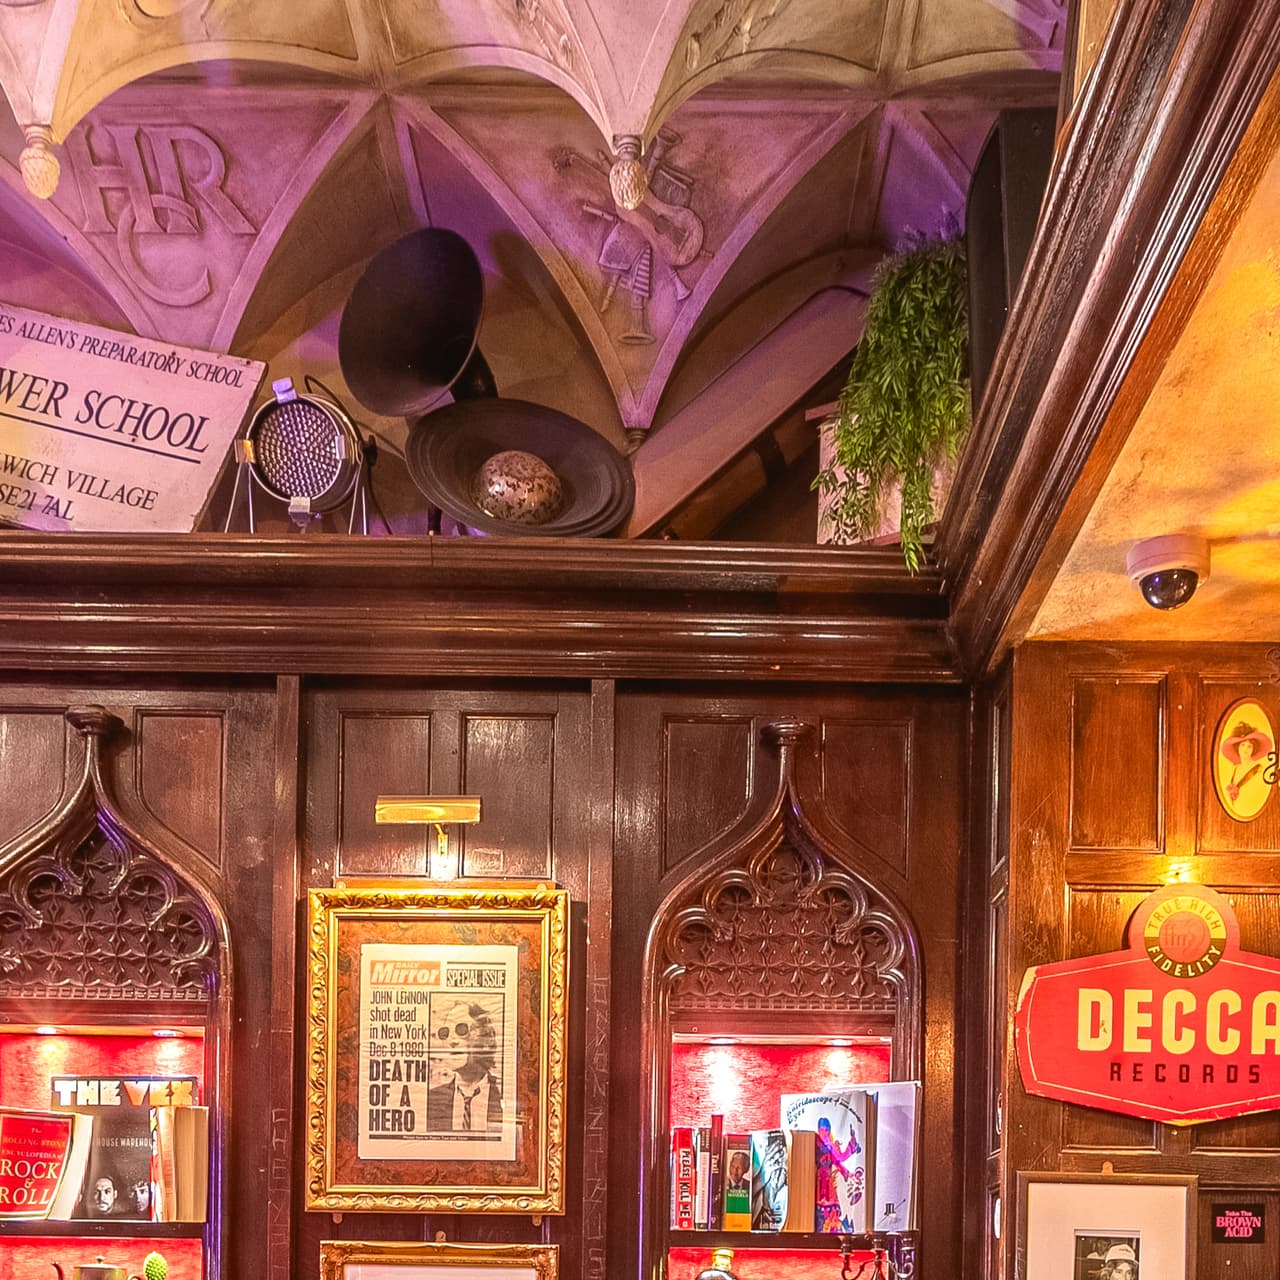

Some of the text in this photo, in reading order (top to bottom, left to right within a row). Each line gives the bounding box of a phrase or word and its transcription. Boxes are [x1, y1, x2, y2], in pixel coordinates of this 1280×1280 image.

[16, 321, 79, 349] ALLEN'S
[80, 336, 185, 375] PREPARATORY
[189, 361, 245, 388] SCHOOL
[75, 390, 210, 453] SCHOOL
[66, 471, 159, 511] VILLAGE
[42, 496, 75, 521] 7AL
[1147, 899, 1222, 930] TRUE HIGH
[1147, 945, 1222, 978] FIDELITY
[371, 963, 439, 984] Mirror
[447, 970, 505, 988] SPECIAL ISSUE
[370, 991, 428, 1005] JOHN LENNON
[370, 1007, 416, 1022] shot dead
[370, 1025, 427, 1040] in New York
[370, 1042, 424, 1058] Dec 8 1980
[369, 1059, 427, 1082] DEATH
[1109, 1063, 1260, 1084] RECORDS
[54, 1080, 121, 1106] THE
[369, 1084, 411, 1107] OF A
[369, 1109, 415, 1132] HERO
[0, 1159, 61, 1179] ROCK
[679, 1150, 691, 1217] PLEASE KILL ME
[1216, 1216, 1262, 1228] BROWN
[1224, 1226, 1253, 1238] ACID
